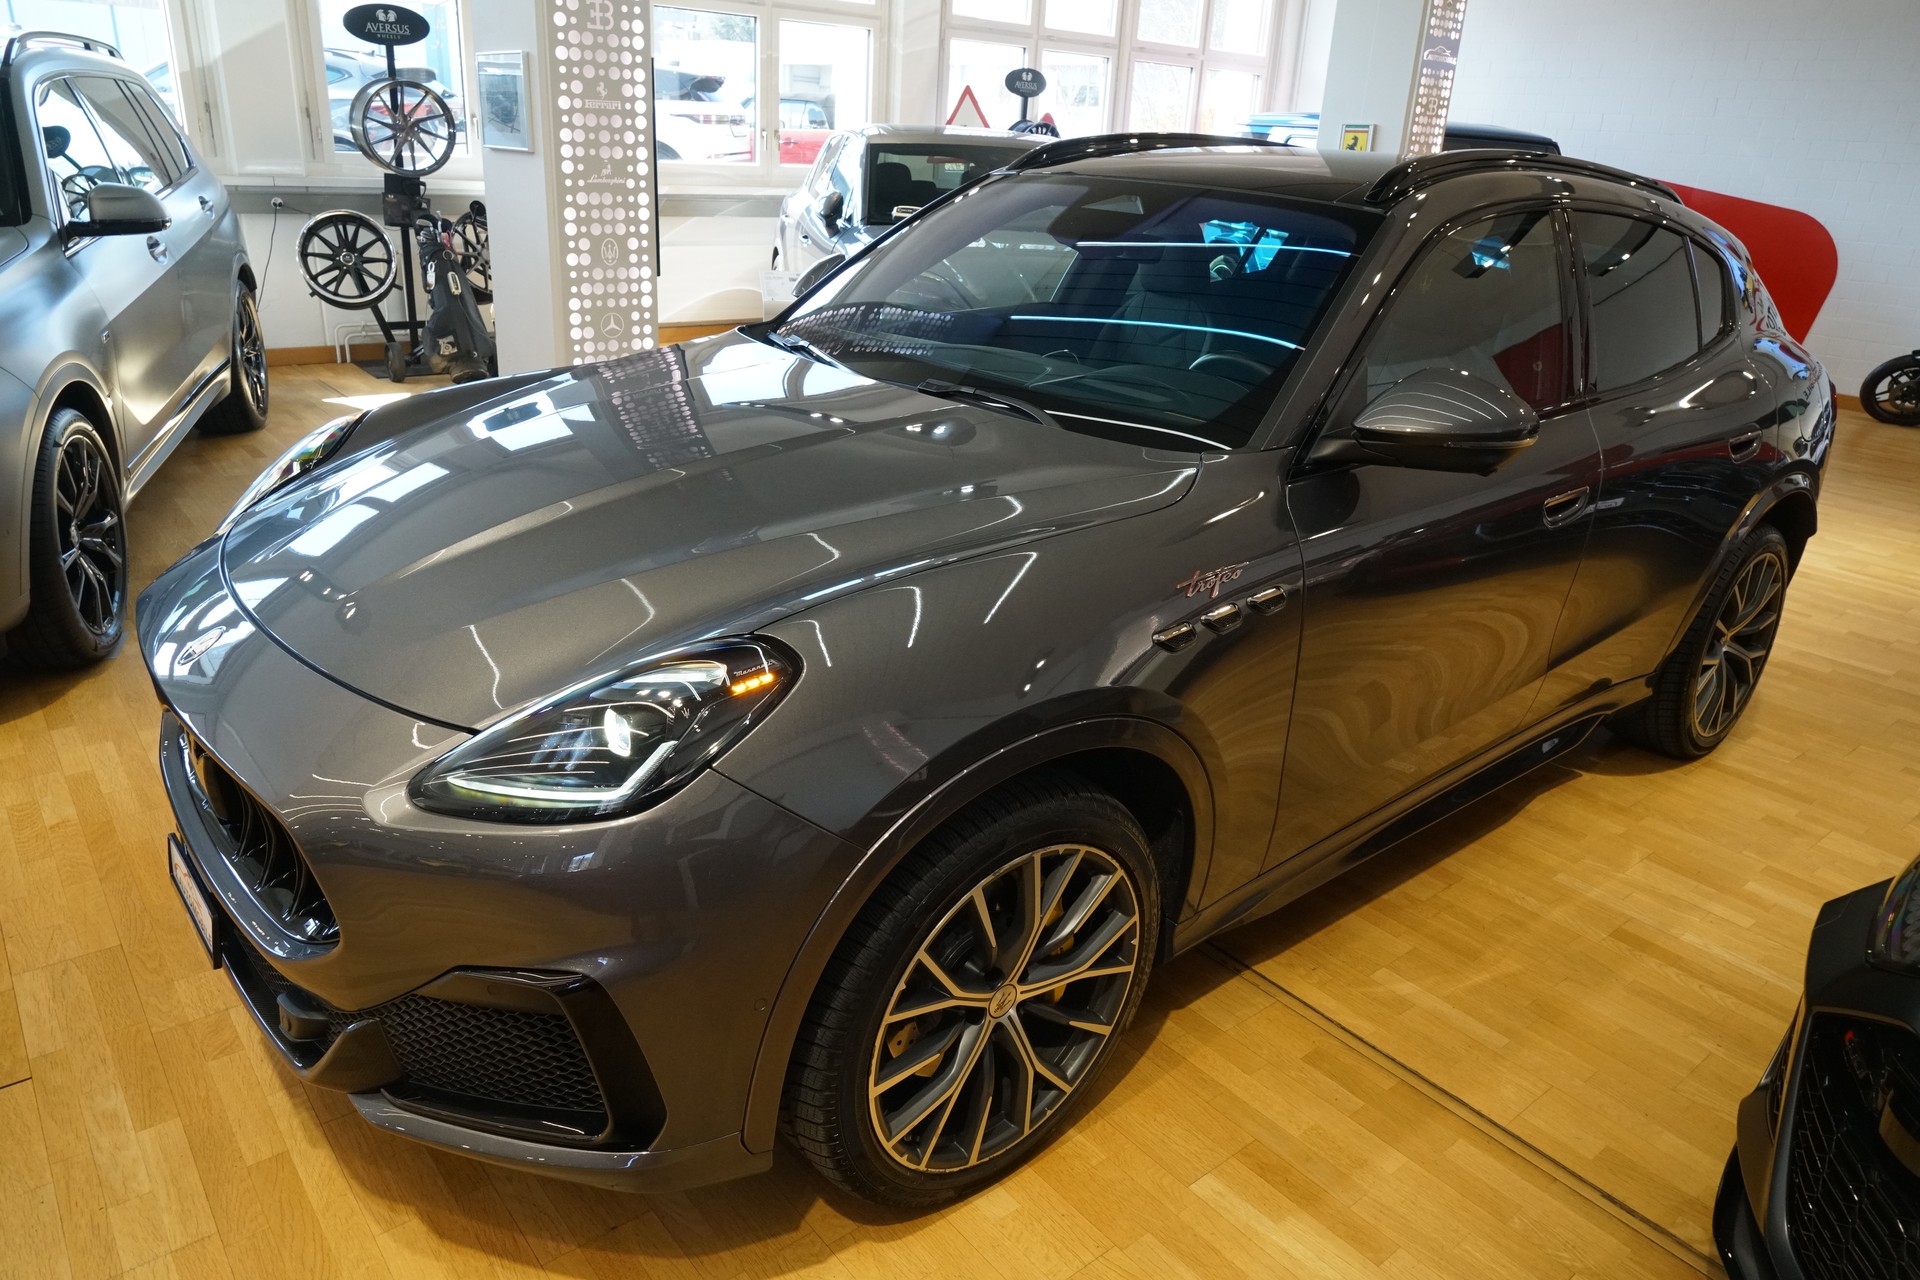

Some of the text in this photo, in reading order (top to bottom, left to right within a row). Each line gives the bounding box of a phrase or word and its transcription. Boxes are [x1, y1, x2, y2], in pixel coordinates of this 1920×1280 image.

[365, 22, 411, 34] AVERSUS
[1015, 80, 1038, 90] AVERSUS
[584, 99, 622, 110] Ferrari
[587, 174, 626, 186] Lamborghini
[1174, 561, 1250, 599] trofeo
